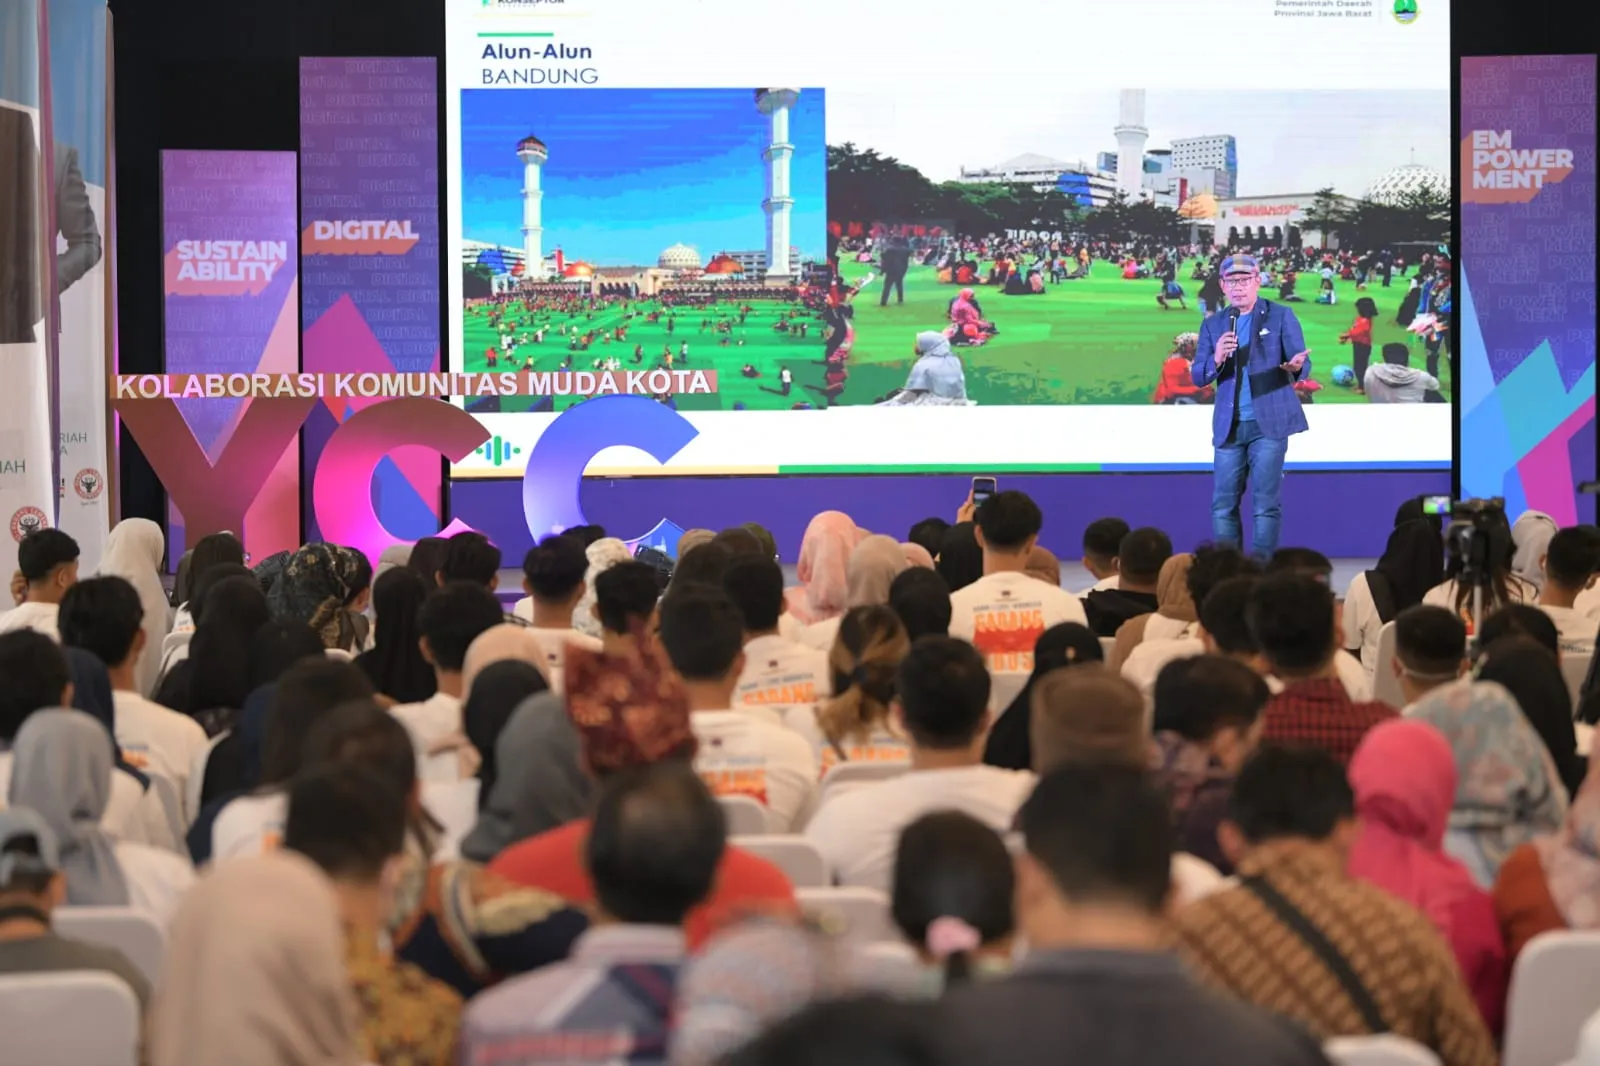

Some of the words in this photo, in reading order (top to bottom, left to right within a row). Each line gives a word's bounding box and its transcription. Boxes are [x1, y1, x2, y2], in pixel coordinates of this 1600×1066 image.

[482, 43, 592, 59] Alun-Alun
[482, 68, 598, 84] BANDUNG
[1472, 130, 1512, 149] EM
[1472, 149, 1574, 169] POWER
[1472, 169, 1548, 189] MENT
[313, 220, 420, 240] DIGITAL
[177, 240, 287, 261] SUSTAIN
[177, 261, 278, 282] ABILITY
[116, 373, 325, 399] KOLABORASI
[334, 372, 518, 397] KOMUNITAS
[528, 371, 619, 396] MUDA
[626, 370, 712, 394] KOTA
